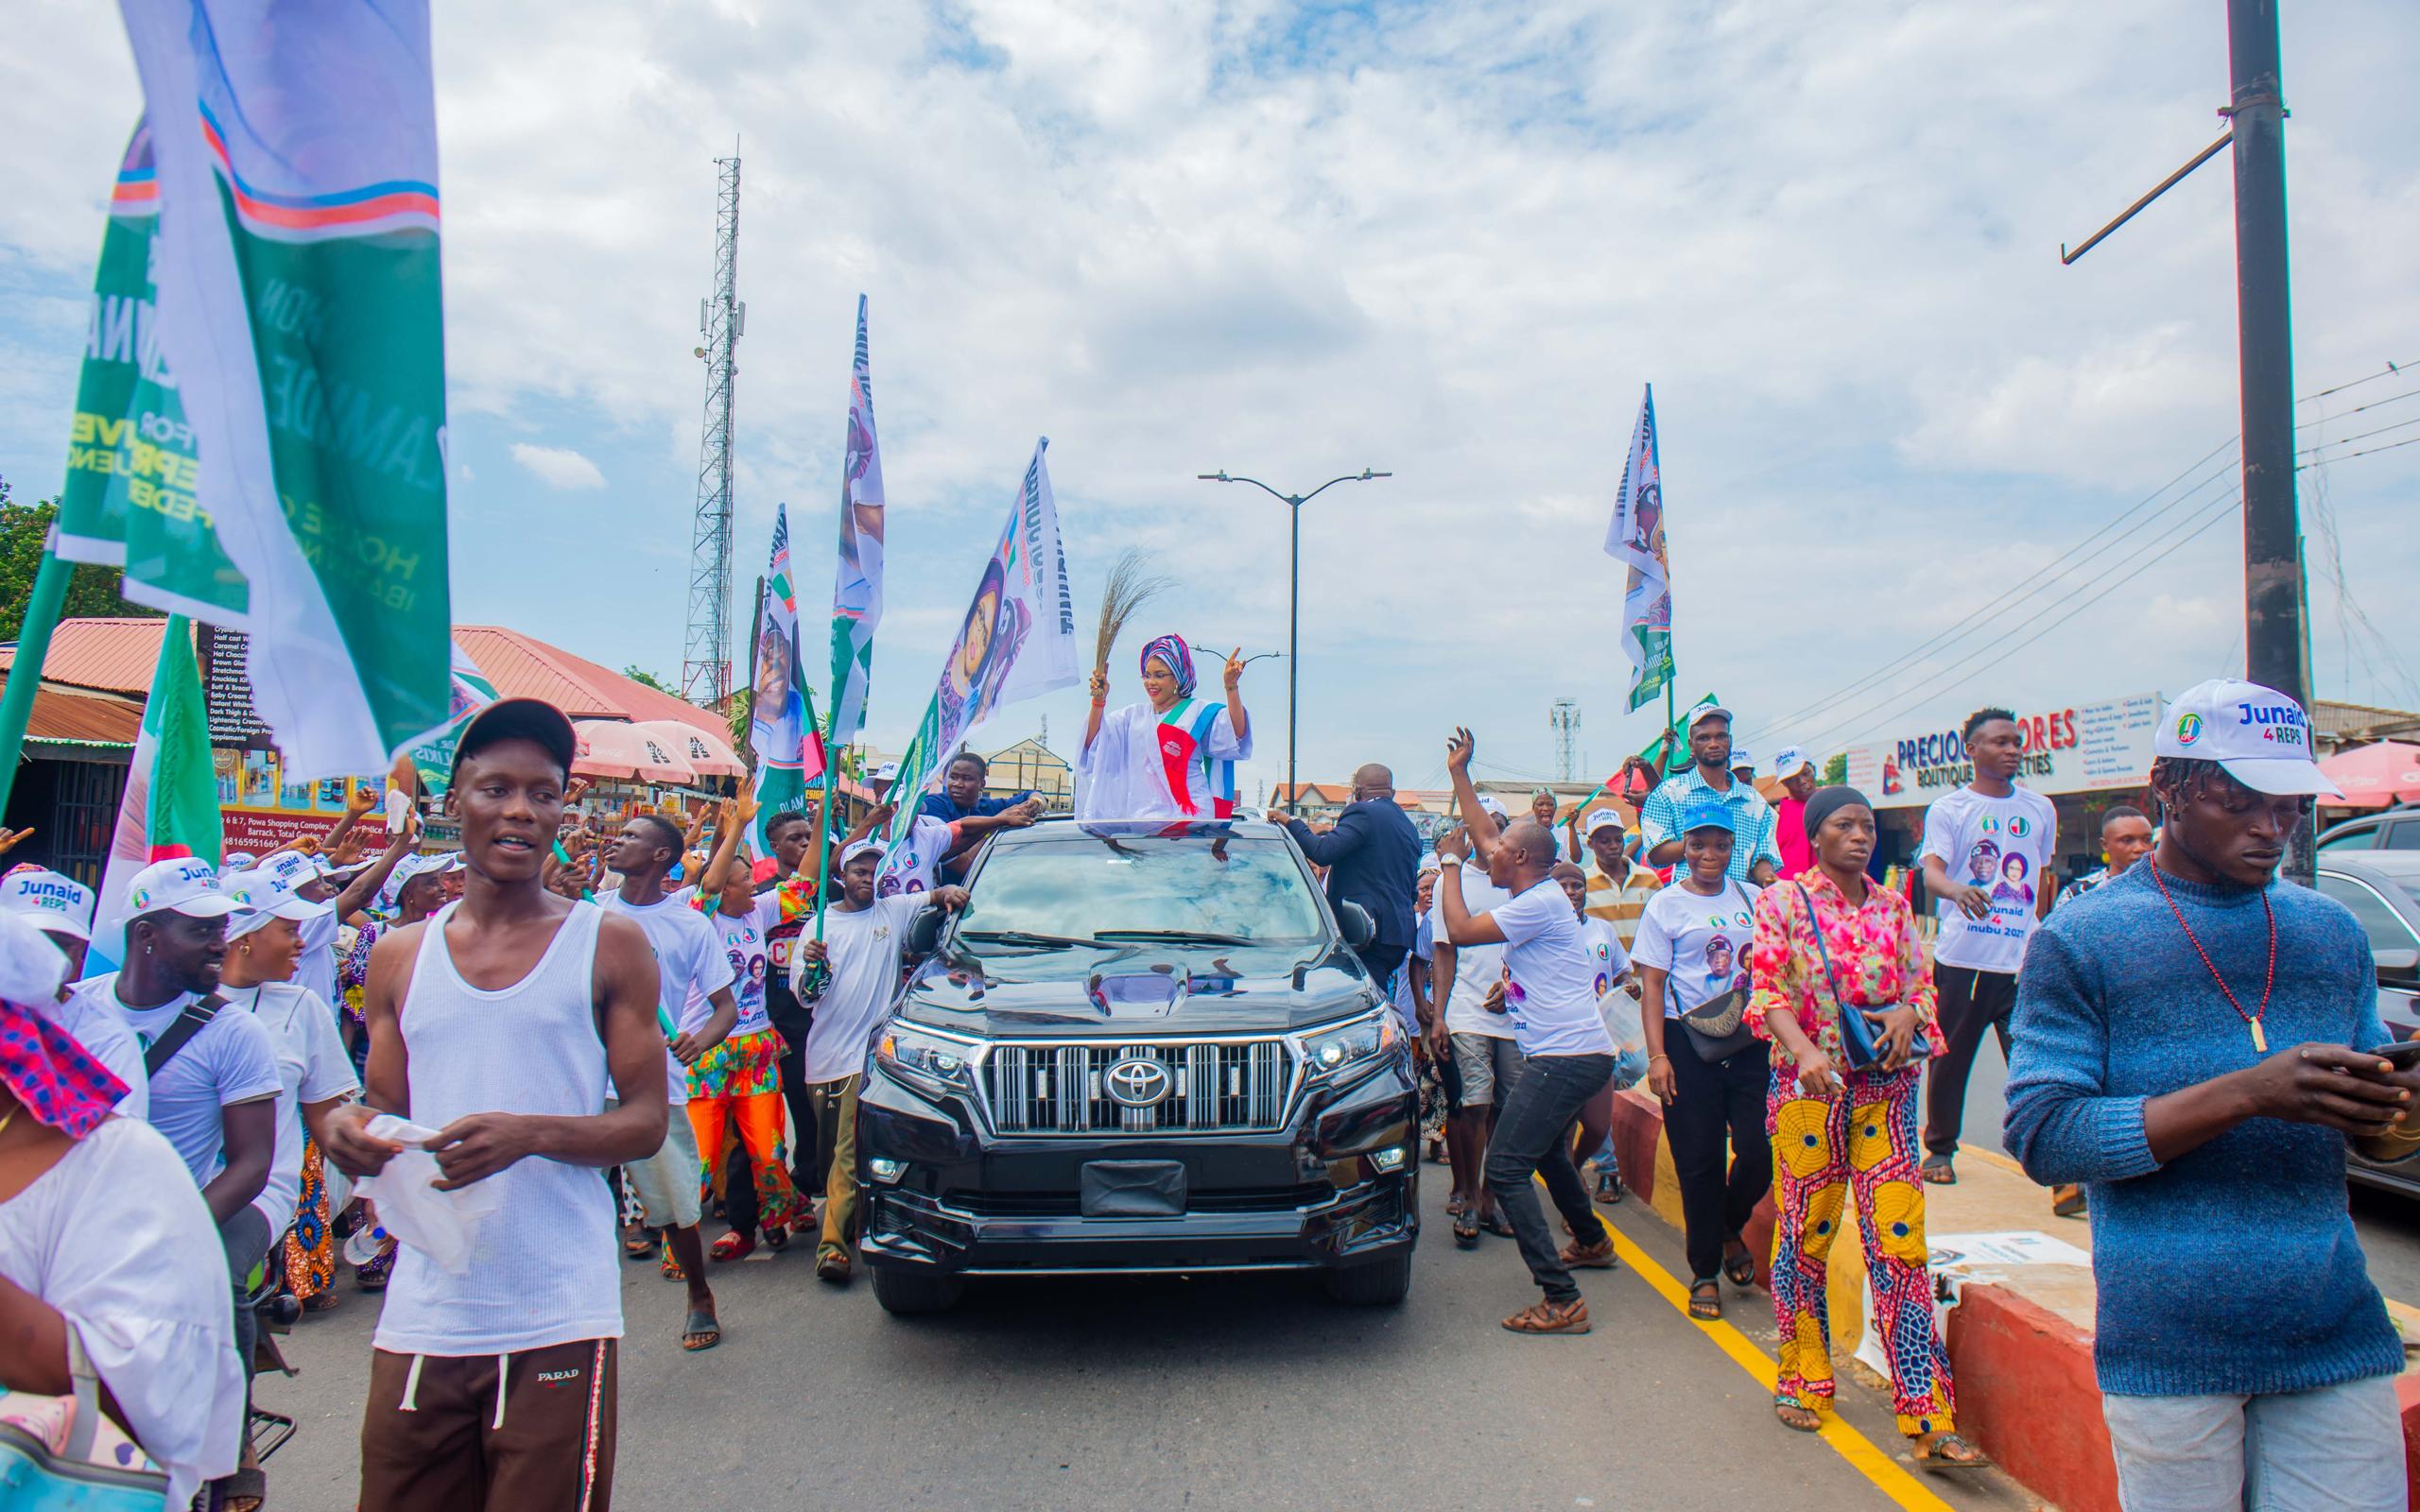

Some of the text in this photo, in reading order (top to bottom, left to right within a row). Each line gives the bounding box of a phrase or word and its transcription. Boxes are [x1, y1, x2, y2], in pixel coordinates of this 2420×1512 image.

[211, 675, 238, 683] Knuckles
[210, 692, 226, 700] Baby
[209, 708, 224, 716] Dark
[225, 708, 242, 717] Thigh
[2238, 702, 2307, 729] Junaid
[209, 716, 241, 726] Lightening
[1897, 709, 2077, 771] PRECIOU ORES
[2263, 727, 2302, 746] 4 REPS
[1917, 764, 1974, 788] BOUTIQUE
[239, 816, 246, 825] 7,
[248, 817, 266, 826] Powa
[268, 818, 299, 830] Shopping
[300, 820, 332, 832] Complex,
[248, 827, 276, 838] Barrack,
[278, 829, 295, 838] Total
[19, 880, 82, 905] Junaid
[41, 897, 67, 912] REPS
[1991, 915, 2002, 925] 4
[537, 1368, 579, 1382] PARAD
